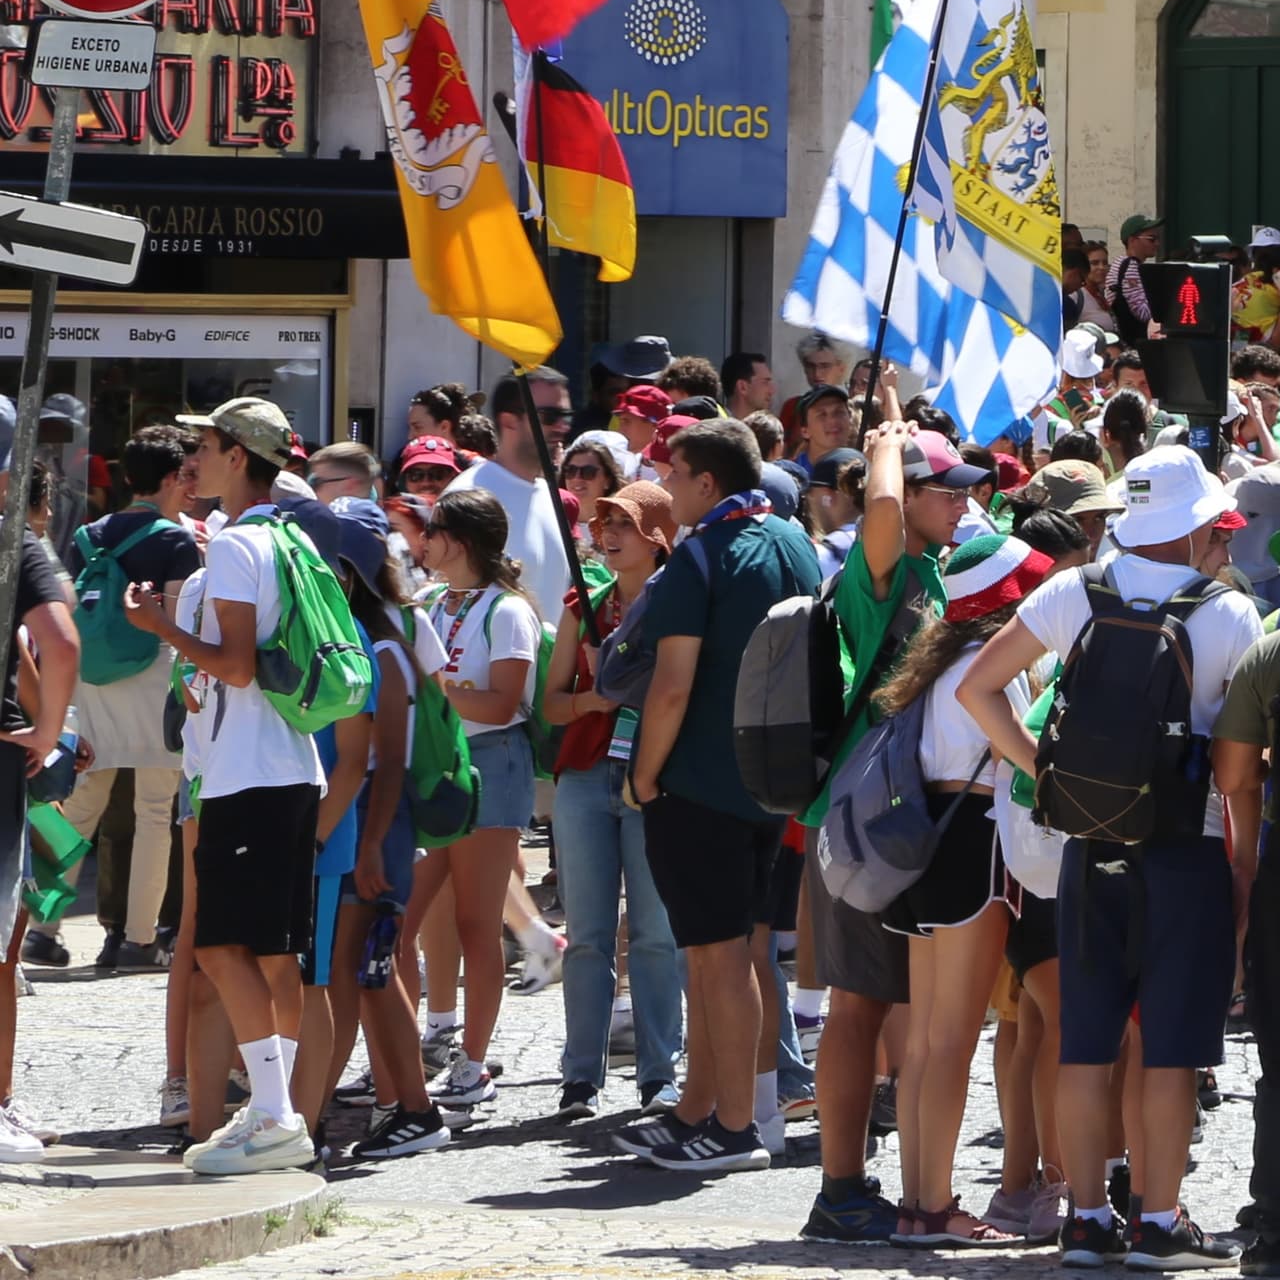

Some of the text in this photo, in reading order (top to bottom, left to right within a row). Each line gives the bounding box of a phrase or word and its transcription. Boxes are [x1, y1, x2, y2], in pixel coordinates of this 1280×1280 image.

[71, 37, 121, 53] EXCETO
[36, 56, 149, 75] HIGIENE URBANA
[604, 88, 769, 148] ltiOpticas
[235, 207, 324, 237] ROSSIO
[150, 239, 253, 254] DESDE 1931
[129, 329, 177, 344] Baby-G
[204, 330, 251, 342] EDIFICE
[278, 331, 321, 343] PRO TREK
